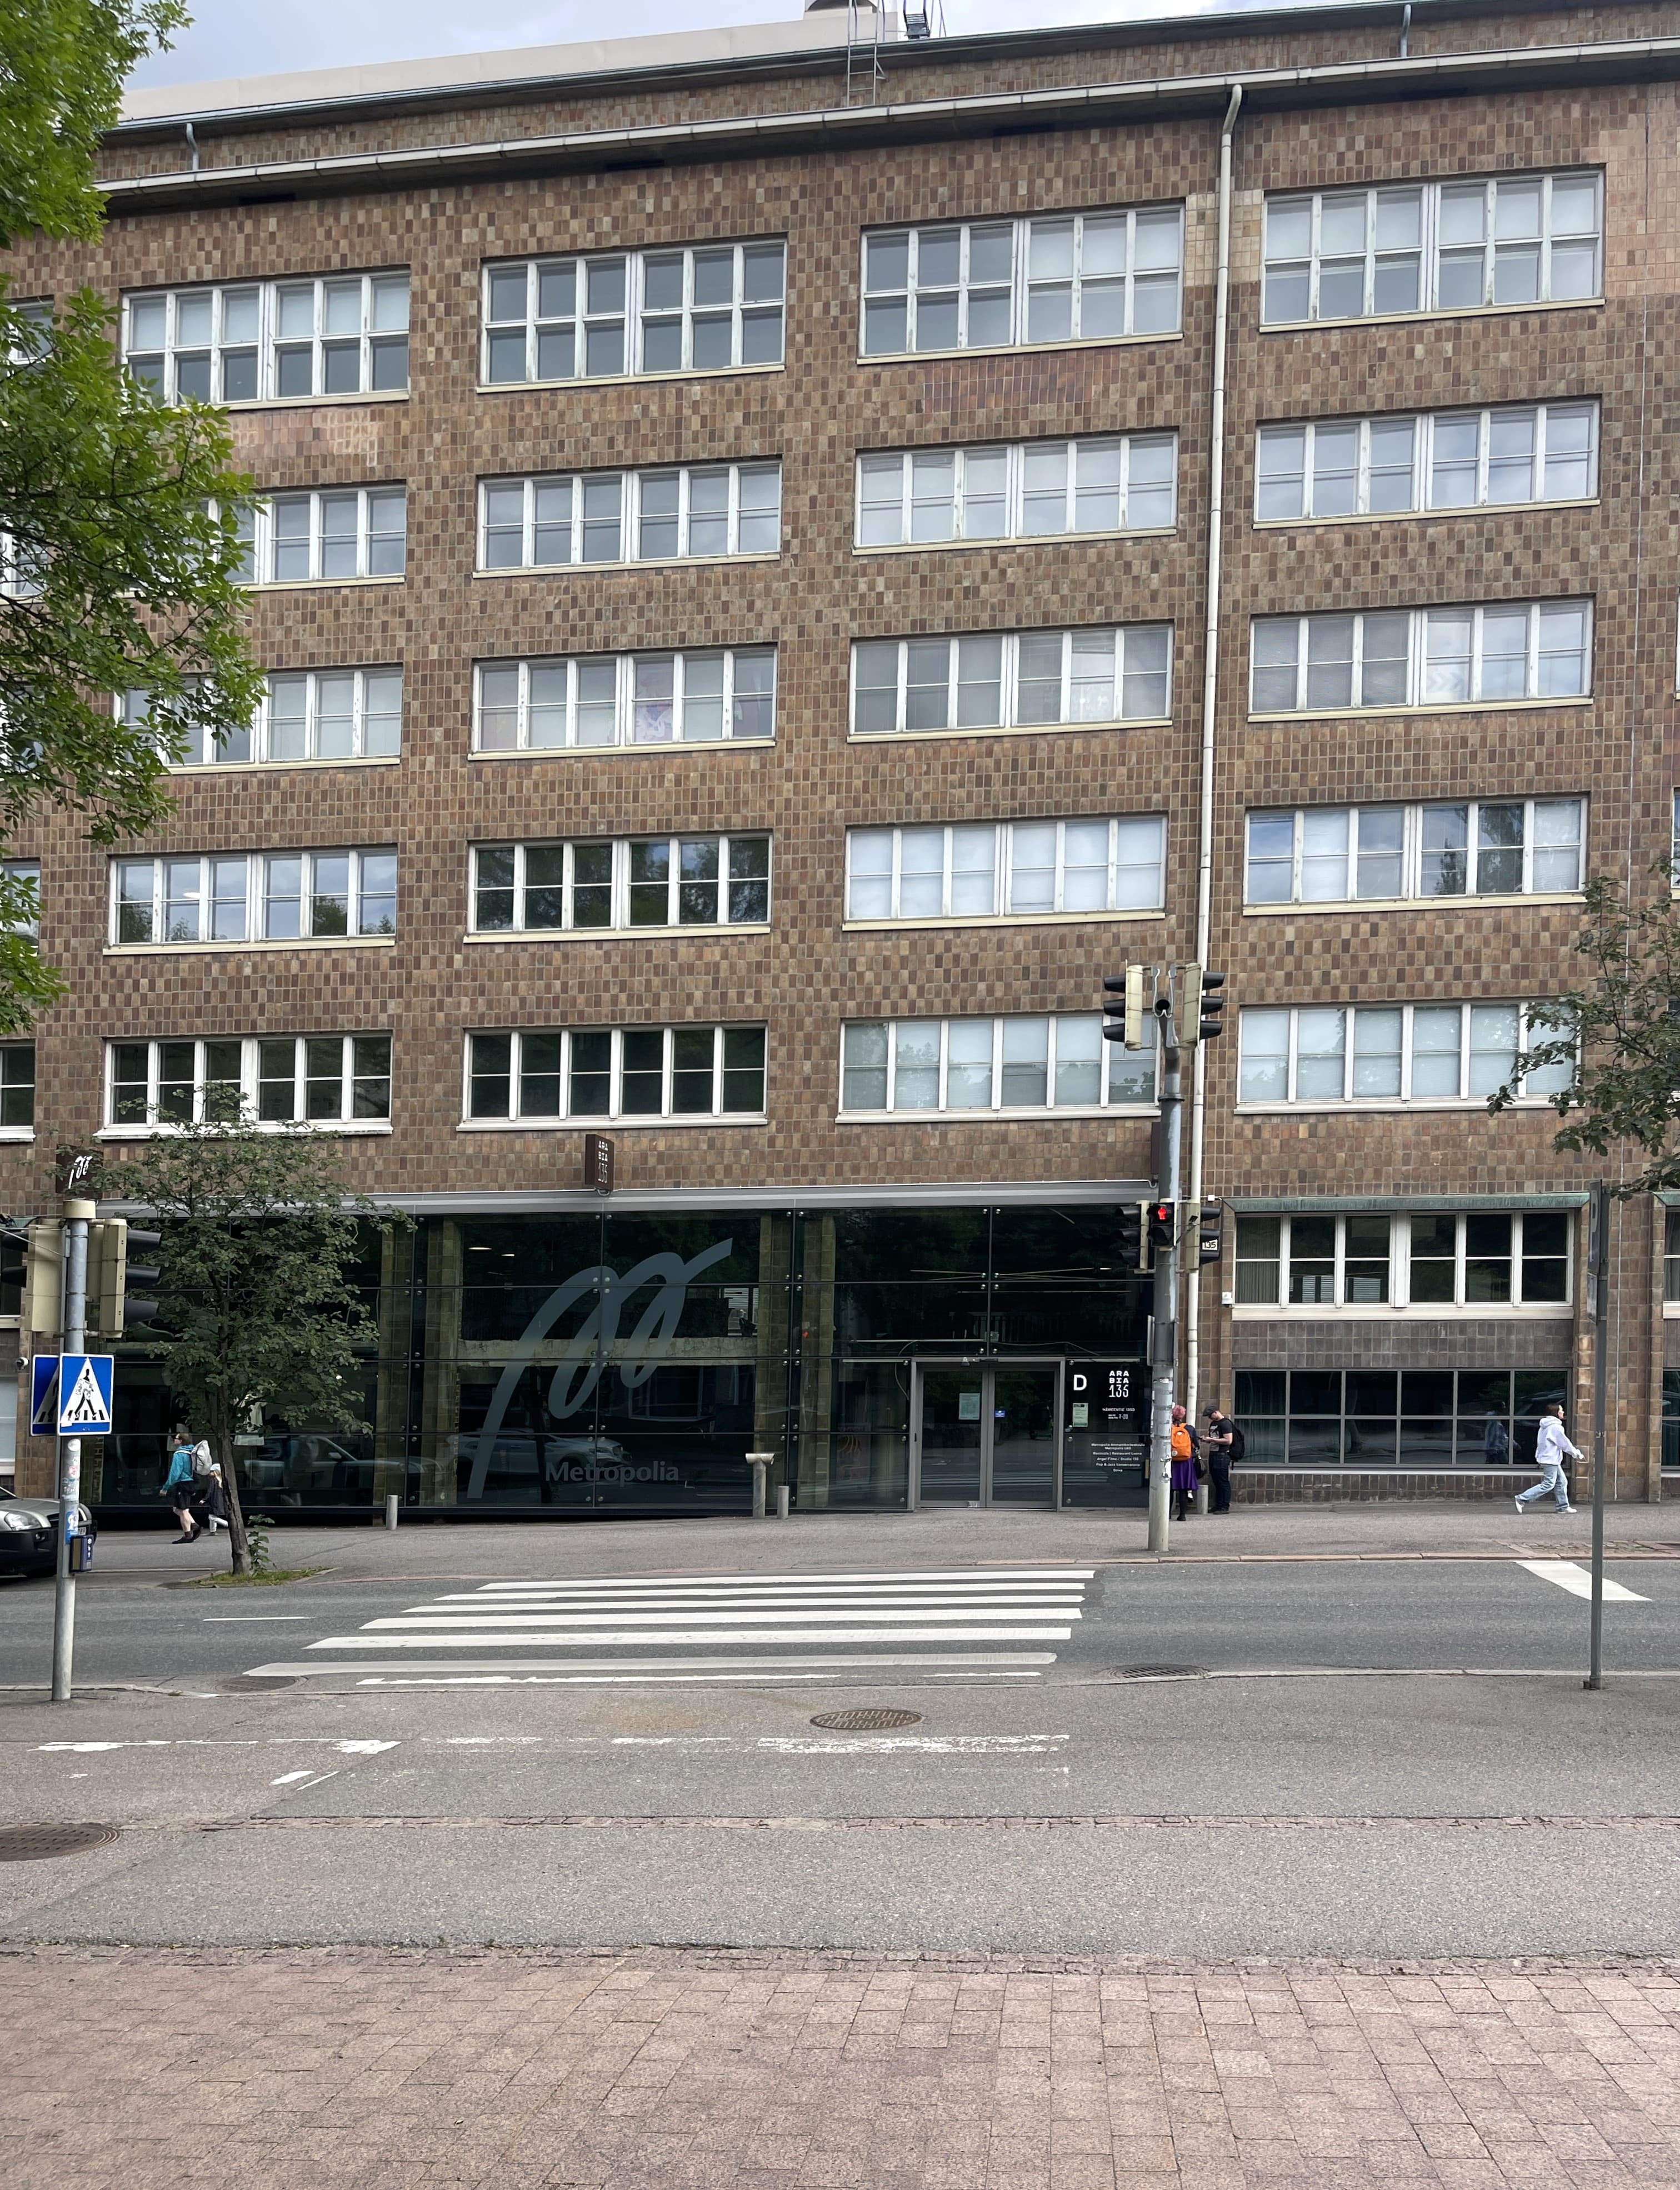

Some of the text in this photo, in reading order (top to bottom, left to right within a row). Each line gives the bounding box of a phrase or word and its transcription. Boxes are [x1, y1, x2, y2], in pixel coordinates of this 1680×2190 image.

[598, 1141, 608, 1151] ARA
[598, 1152, 608, 1162] BIA
[598, 1162, 608, 1183] 135
[1073, 1374, 1087, 1391] D
[545, 1461, 679, 1487] Metropolia
